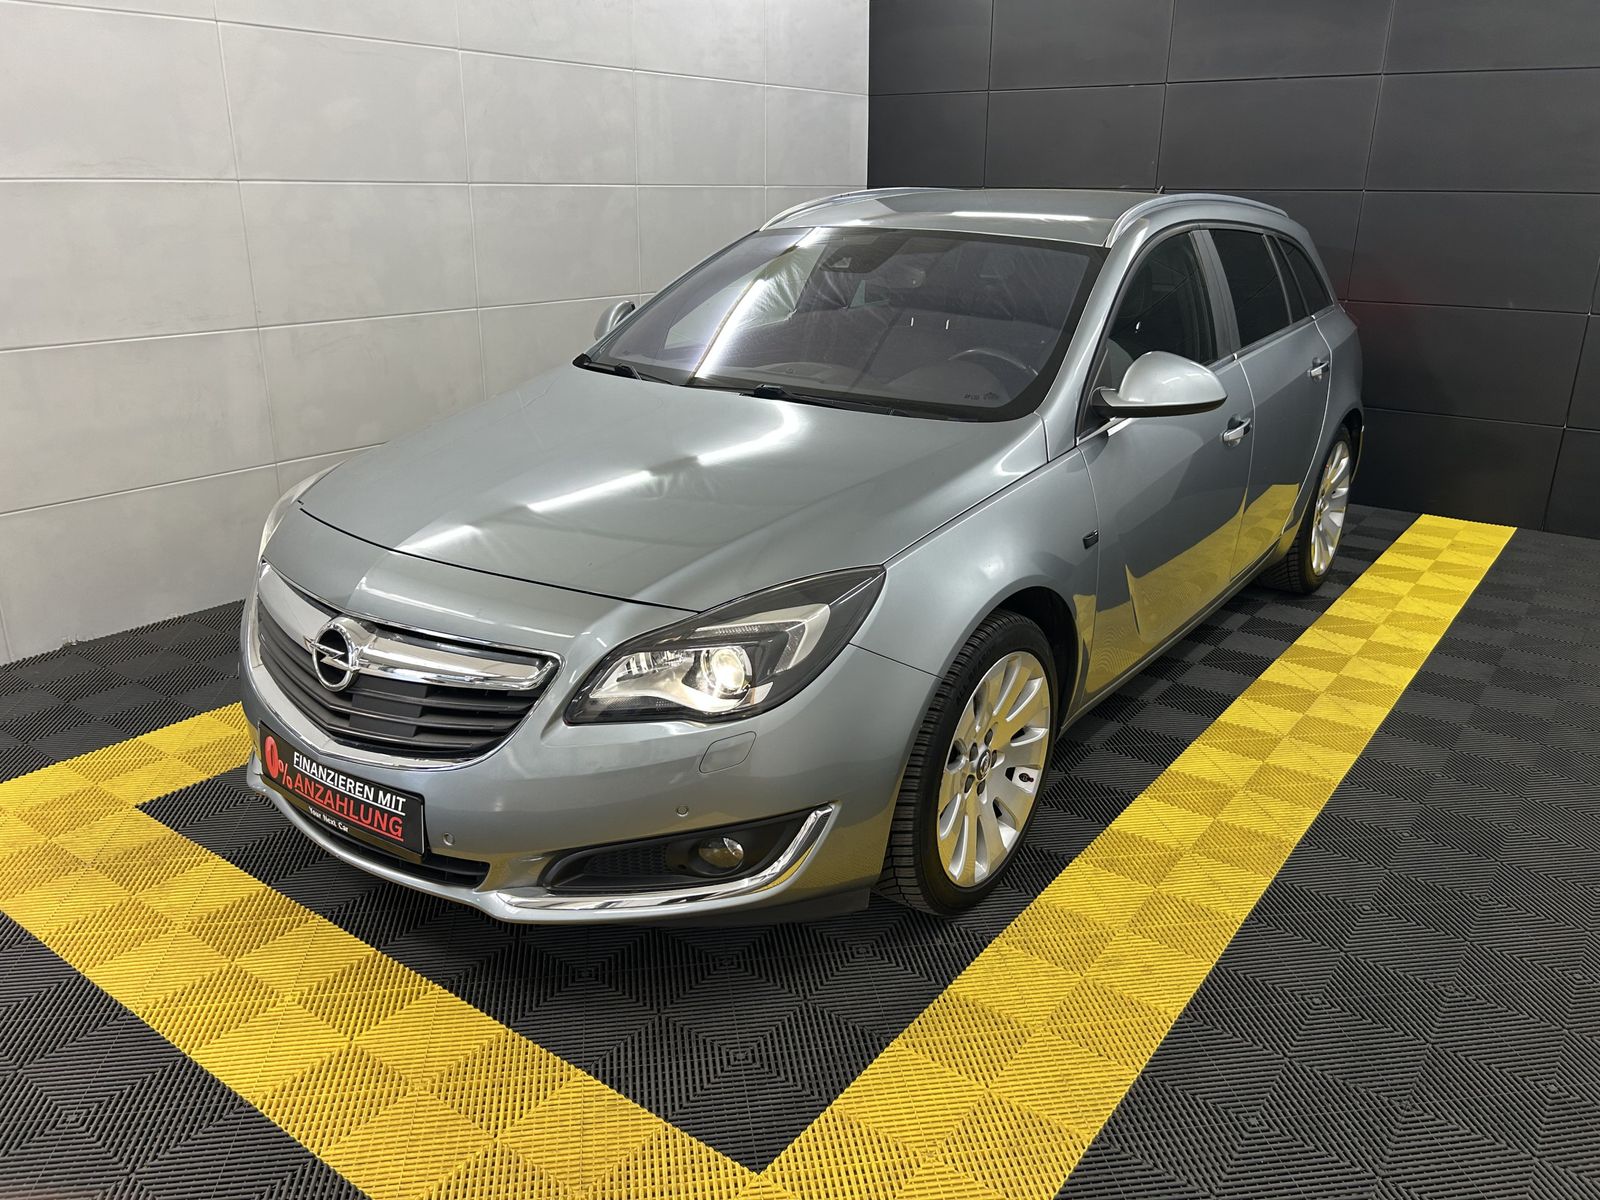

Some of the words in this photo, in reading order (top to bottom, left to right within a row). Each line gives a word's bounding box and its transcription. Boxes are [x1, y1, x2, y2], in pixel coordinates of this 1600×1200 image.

[293, 751, 375, 801] FINANZIEREN
[377, 790, 406, 812] MIT
[294, 772, 403, 837] ANZAHLUNG
[308, 805, 322, 819] Your
[322, 814, 337, 827] Next
[337, 822, 349, 832] Car
